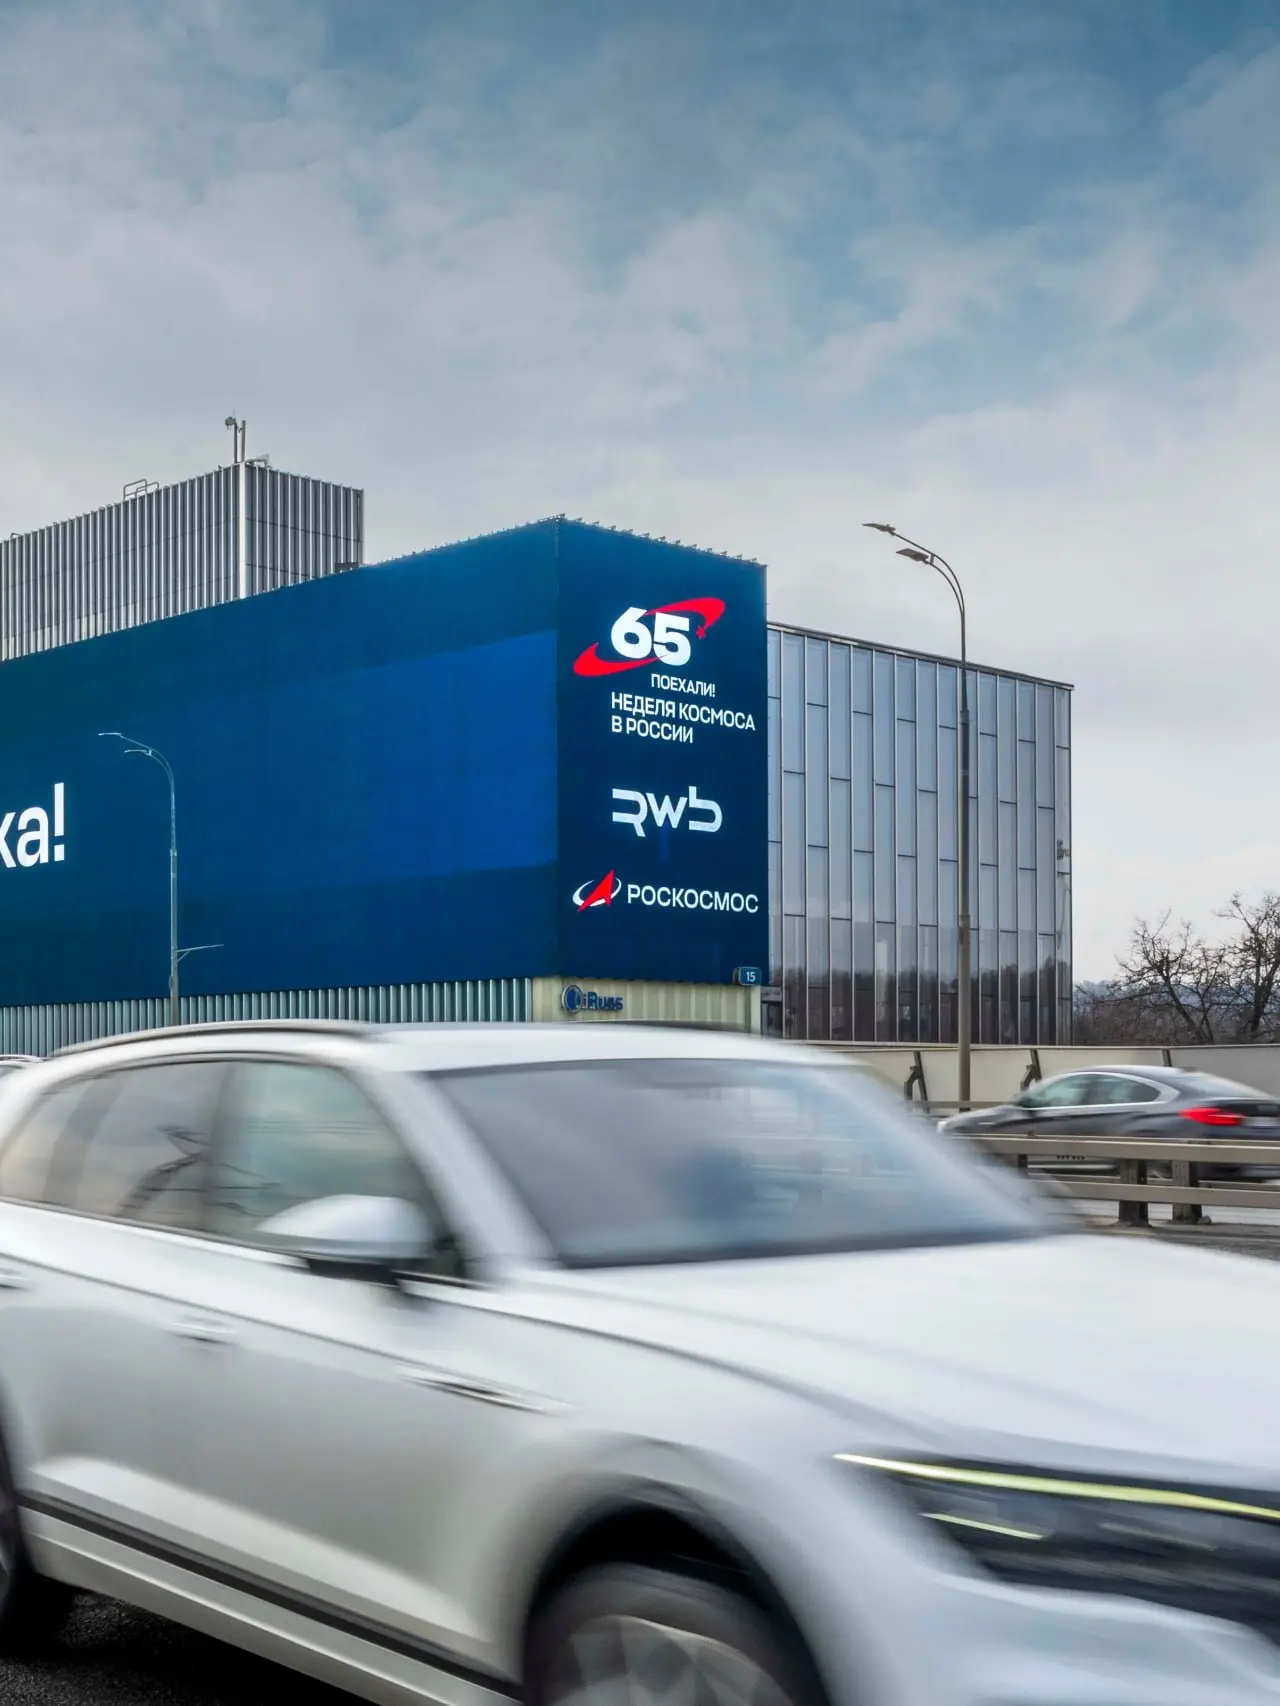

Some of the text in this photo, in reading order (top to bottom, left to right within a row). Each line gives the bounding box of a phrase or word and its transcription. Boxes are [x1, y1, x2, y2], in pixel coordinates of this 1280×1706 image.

[611, 606, 691, 666] 65
[651, 673, 716, 697] ПОЕХАЛИ!
[611, 691, 756, 731] НЕДЕЛЯ КОСМОСА
[611, 715, 694, 743] В РОССИИ
[627, 884, 759, 913] РОСКОСМОС
[746, 971, 756, 983] 15
